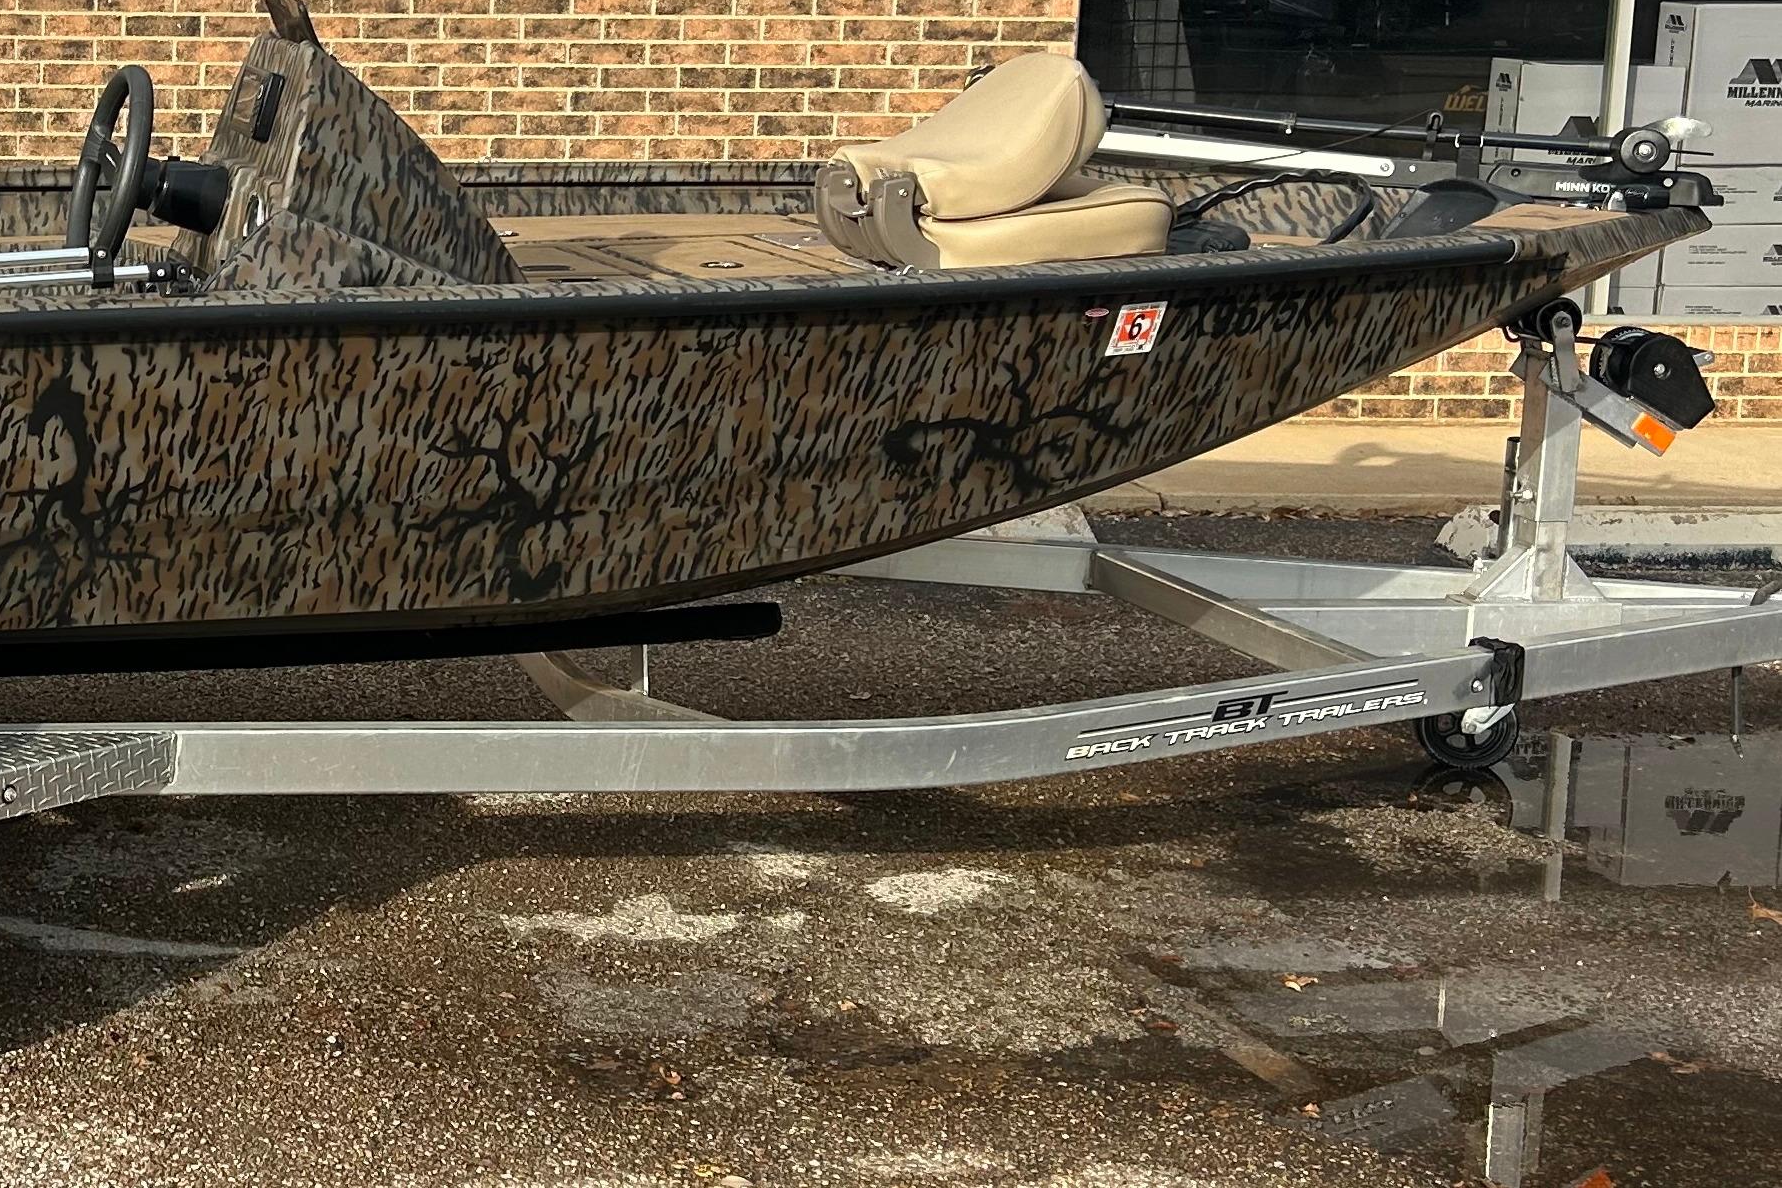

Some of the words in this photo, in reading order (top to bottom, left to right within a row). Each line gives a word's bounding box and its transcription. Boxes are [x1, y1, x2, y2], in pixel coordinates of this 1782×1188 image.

[1555, 181, 1590, 192] MINN
[1592, 183, 1616, 193] KO
[1127, 313, 1146, 340] 6
[1211, 690, 1289, 723] BT
[1065, 734, 1156, 761] BACK
[1164, 716, 1272, 746] TRACK
[1278, 690, 1426, 727] TRAILERS
